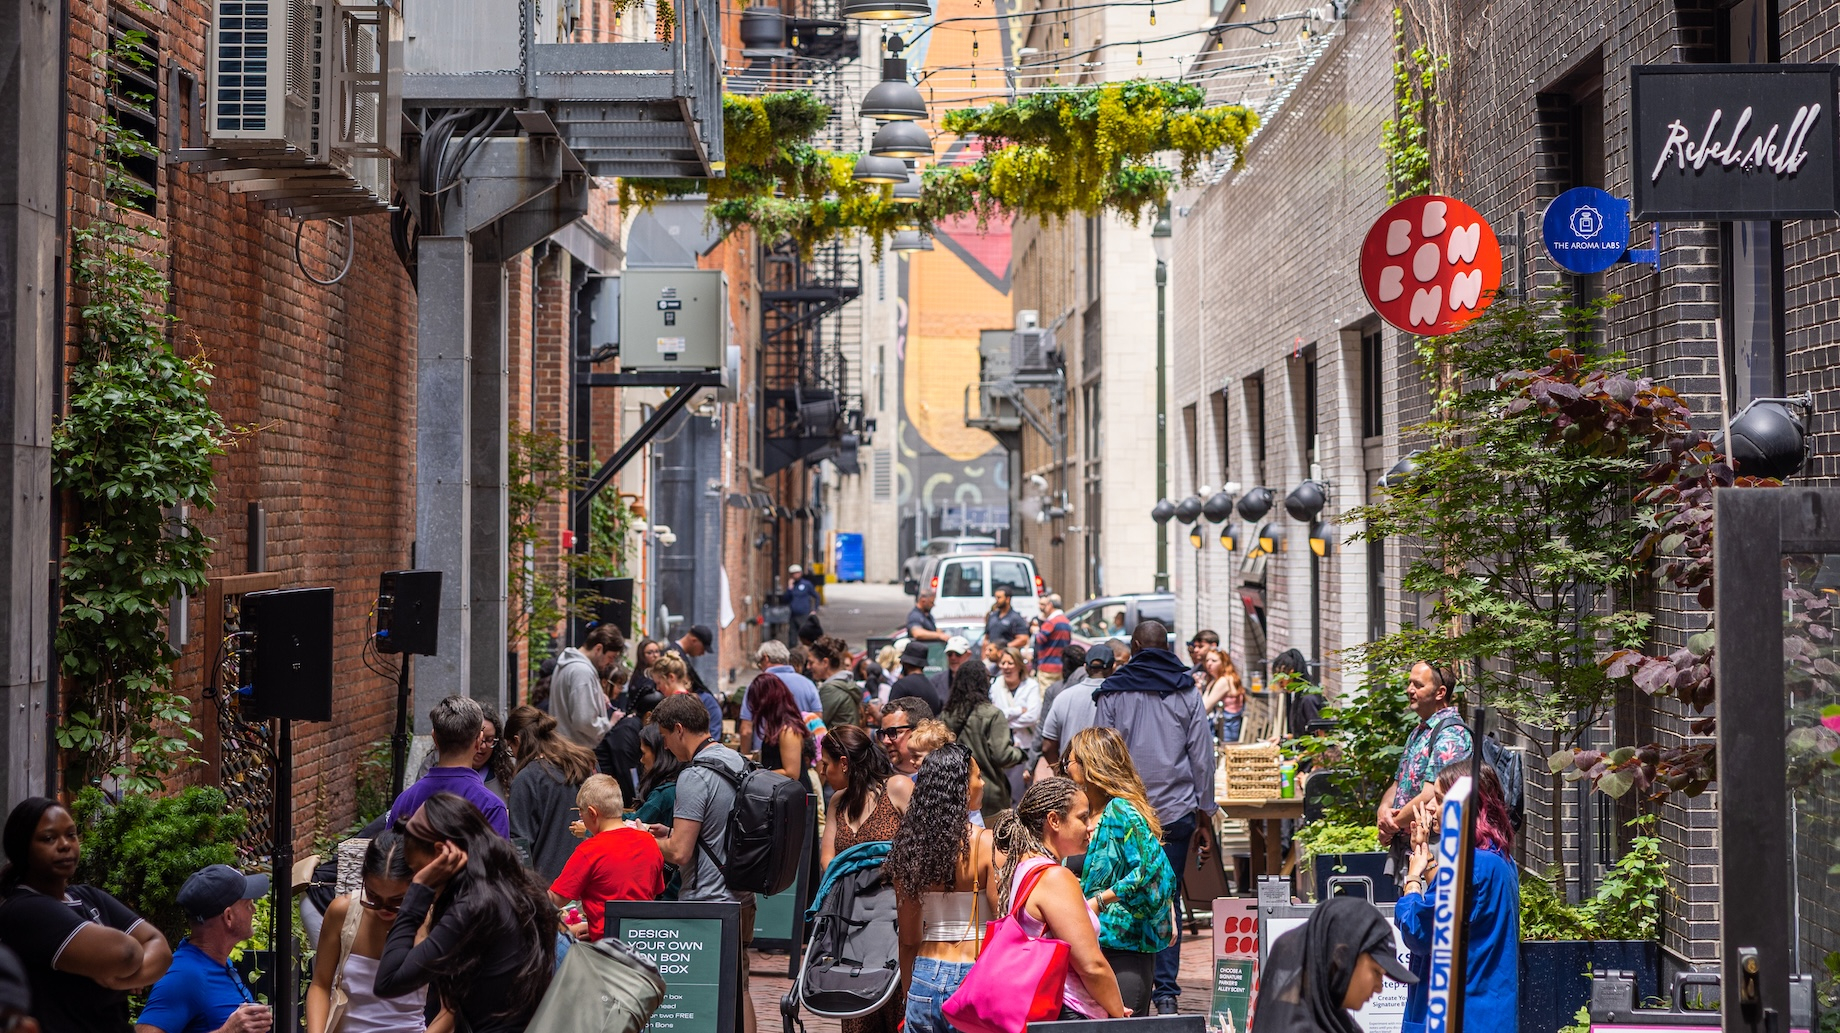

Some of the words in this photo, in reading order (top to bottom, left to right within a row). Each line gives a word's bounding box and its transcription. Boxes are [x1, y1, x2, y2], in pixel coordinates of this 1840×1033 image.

[1651, 105, 1753, 181] Rebel
[1740, 103, 1821, 174] Nell
[628, 929, 679, 939] DESIGN
[627, 941, 666, 950] YOUR
[668, 941, 703, 950] OWN
[660, 953, 690, 962] BON
[660, 965, 689, 974] BOX
[1382, 981, 1400, 990] tep
